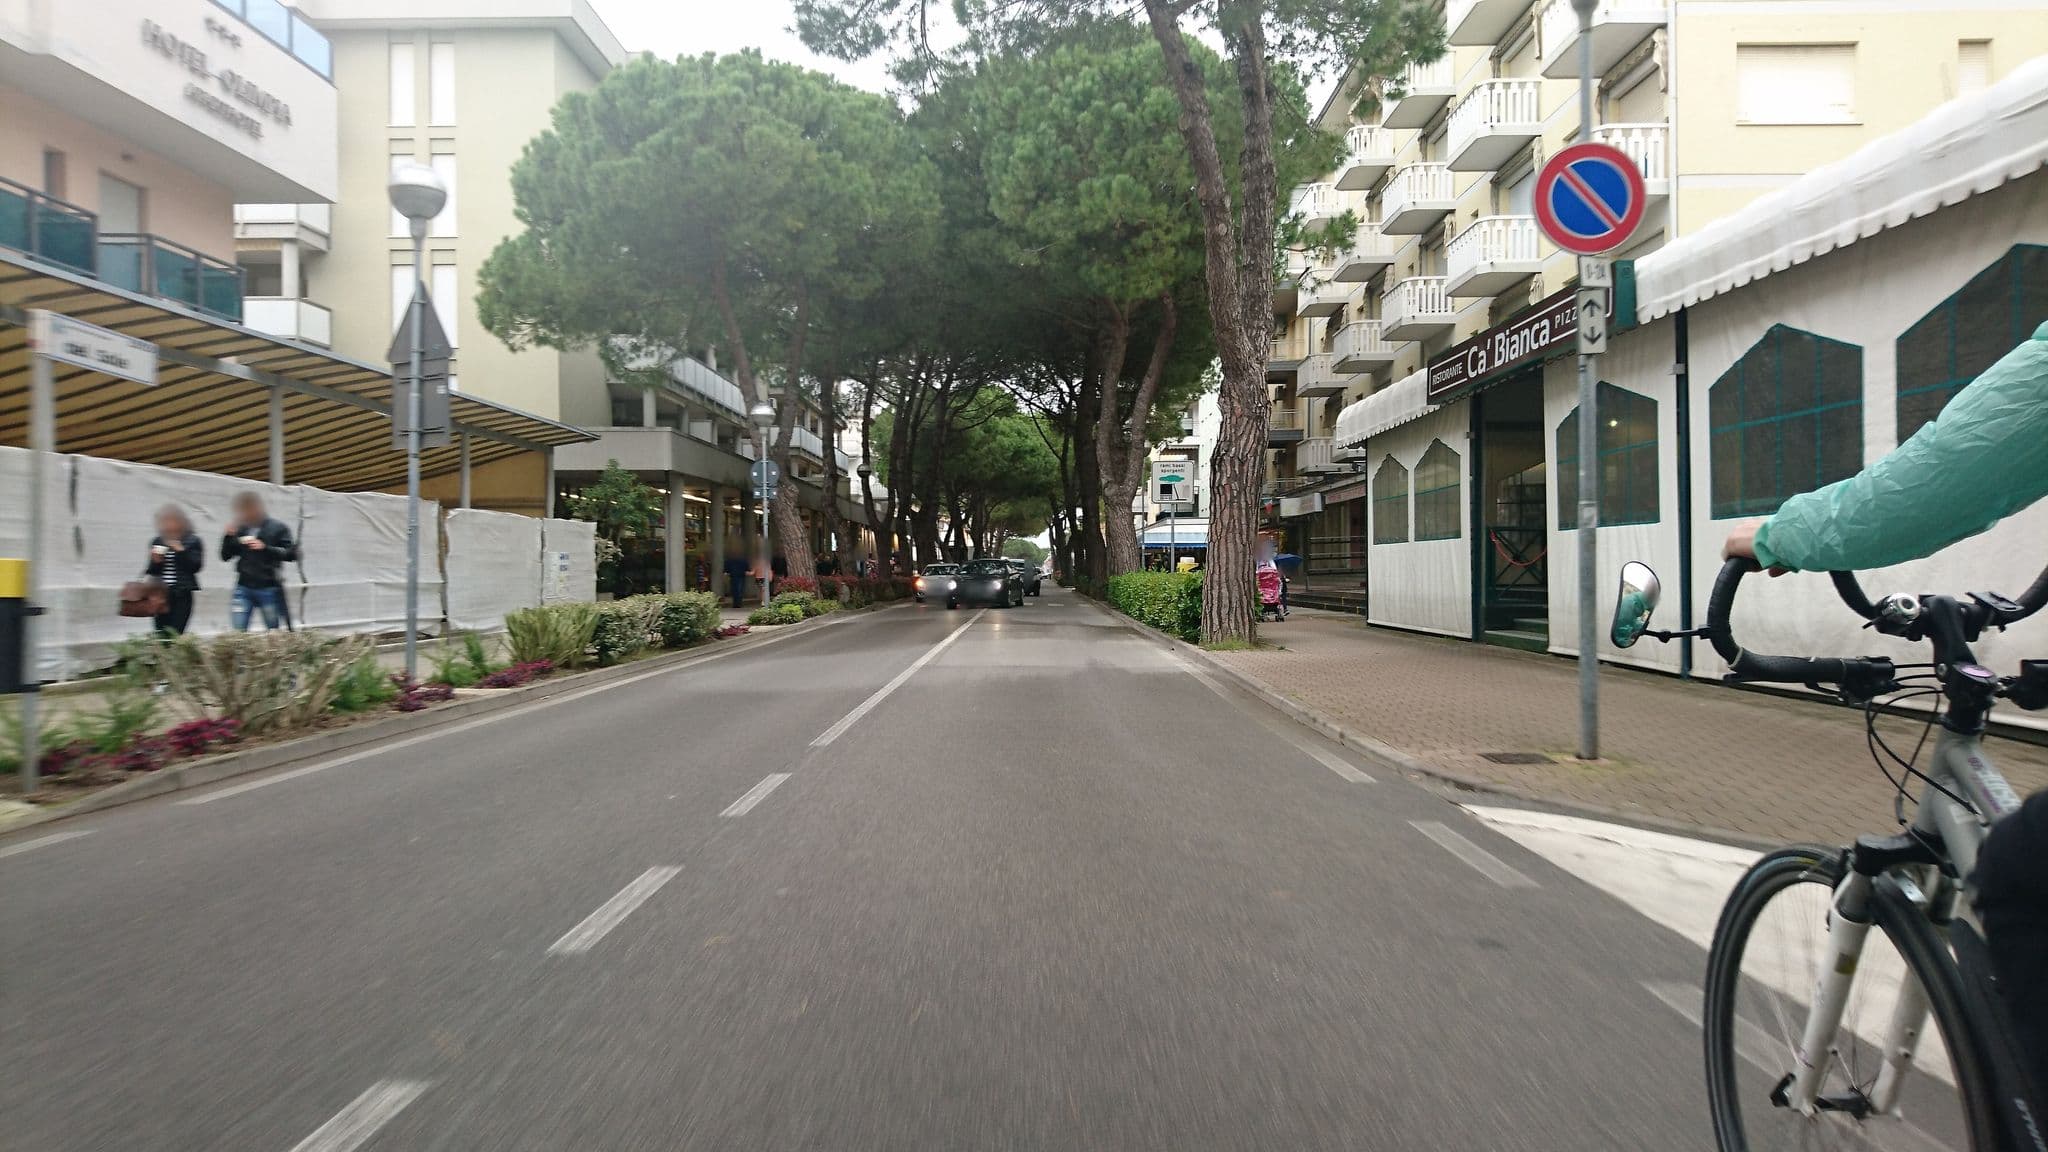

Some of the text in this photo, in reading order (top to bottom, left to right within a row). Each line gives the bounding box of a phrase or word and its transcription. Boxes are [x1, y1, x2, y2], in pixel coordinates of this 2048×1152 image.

[141, 18, 210, 79] HOTEL
[1431, 362, 1463, 386] RISTORANTE
[1494, 318, 1550, 367] Bianca
[1554, 306, 1578, 329] PIZZ
